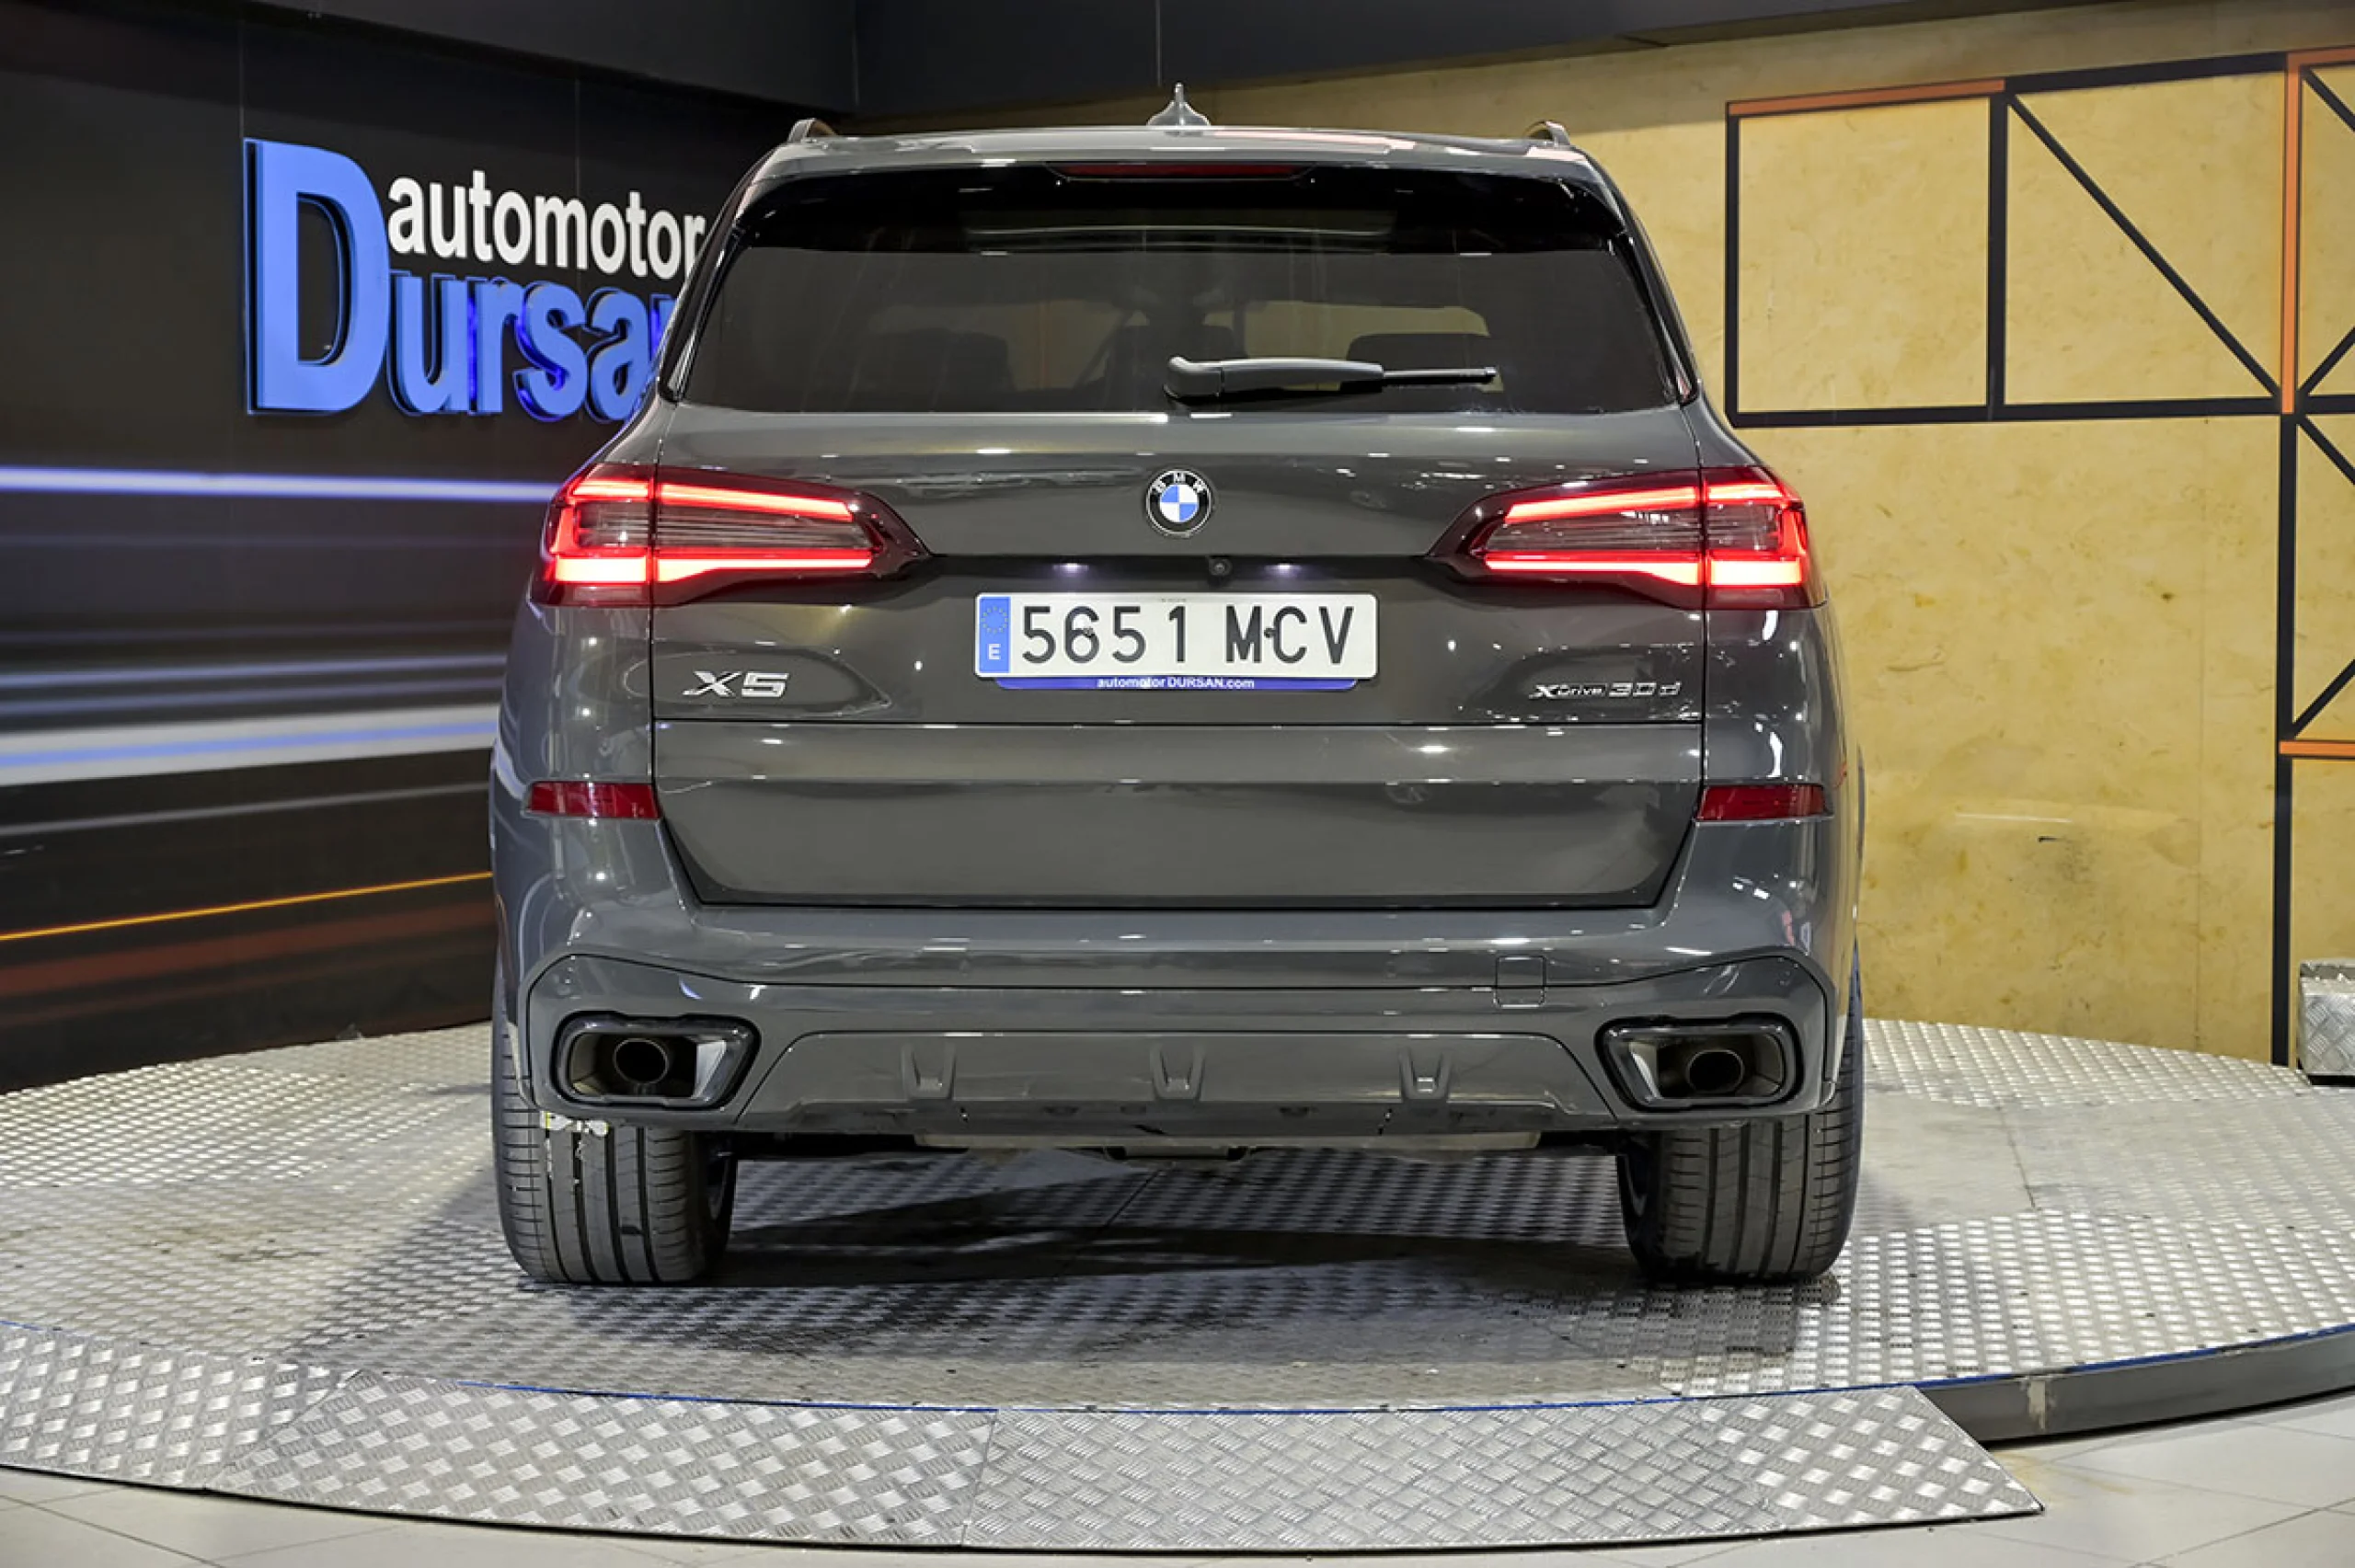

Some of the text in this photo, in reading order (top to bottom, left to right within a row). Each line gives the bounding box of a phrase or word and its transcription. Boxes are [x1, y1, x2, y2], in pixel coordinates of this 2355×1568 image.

[387, 169, 705, 280] automotor
[243, 137, 677, 423] Dursa
[988, 605, 1353, 663] E 5651 MCV
[683, 670, 789, 697] X5
[1097, 677, 1255, 689] automotor DURSAN.com
